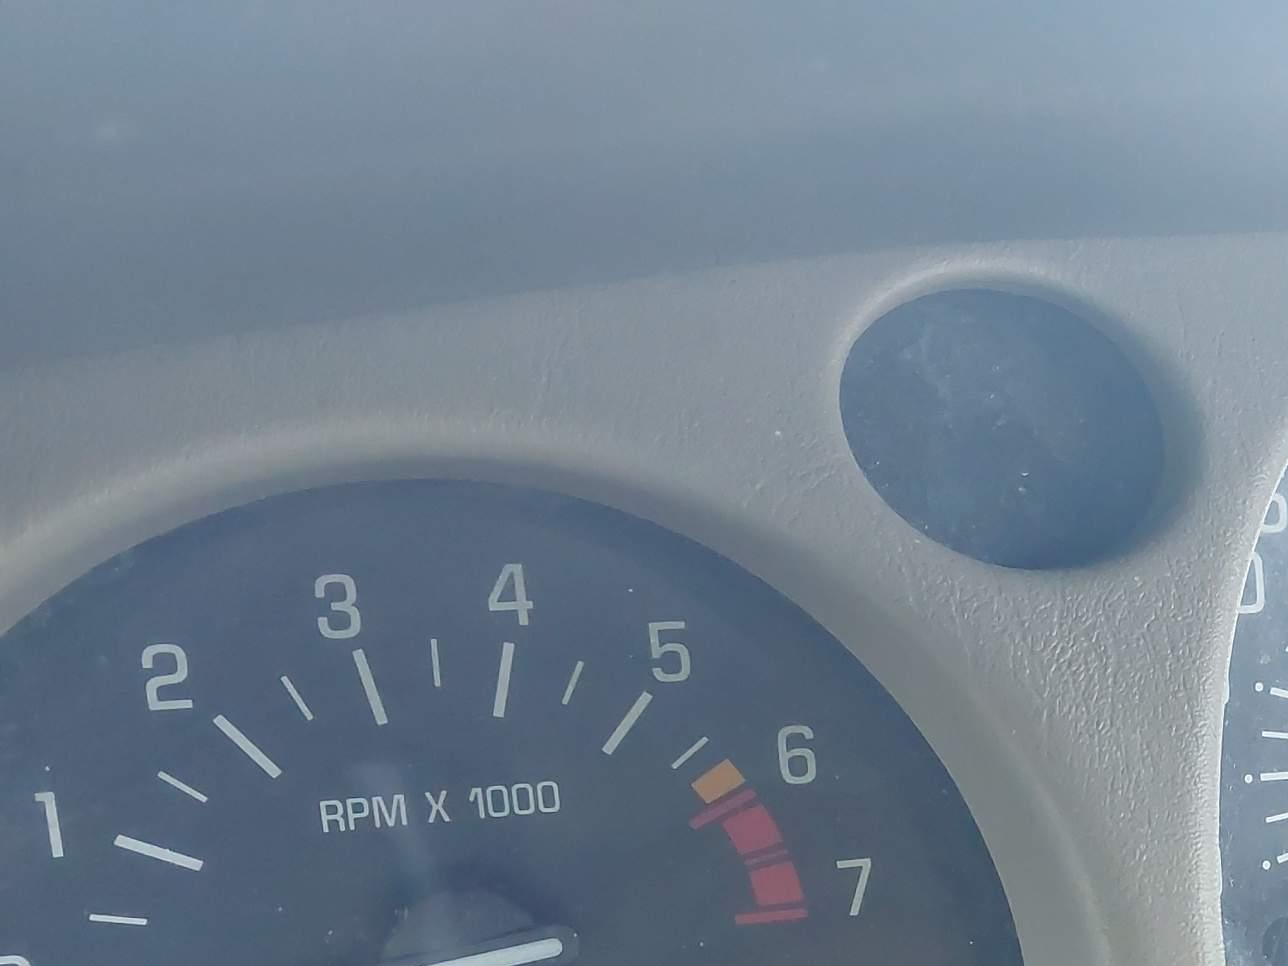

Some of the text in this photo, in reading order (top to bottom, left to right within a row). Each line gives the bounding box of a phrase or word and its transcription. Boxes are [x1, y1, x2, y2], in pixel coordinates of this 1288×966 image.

[315, 574, 362, 639] 3
[488, 563, 534, 627] 4
[141, 644, 193, 711] 2
[648, 621, 692, 683] 5
[776, 725, 817, 785] 6
[34, 792, 64, 857] 1
[319, 780, 561, 833] RPM X 1000
[836, 857, 872, 916] 7
